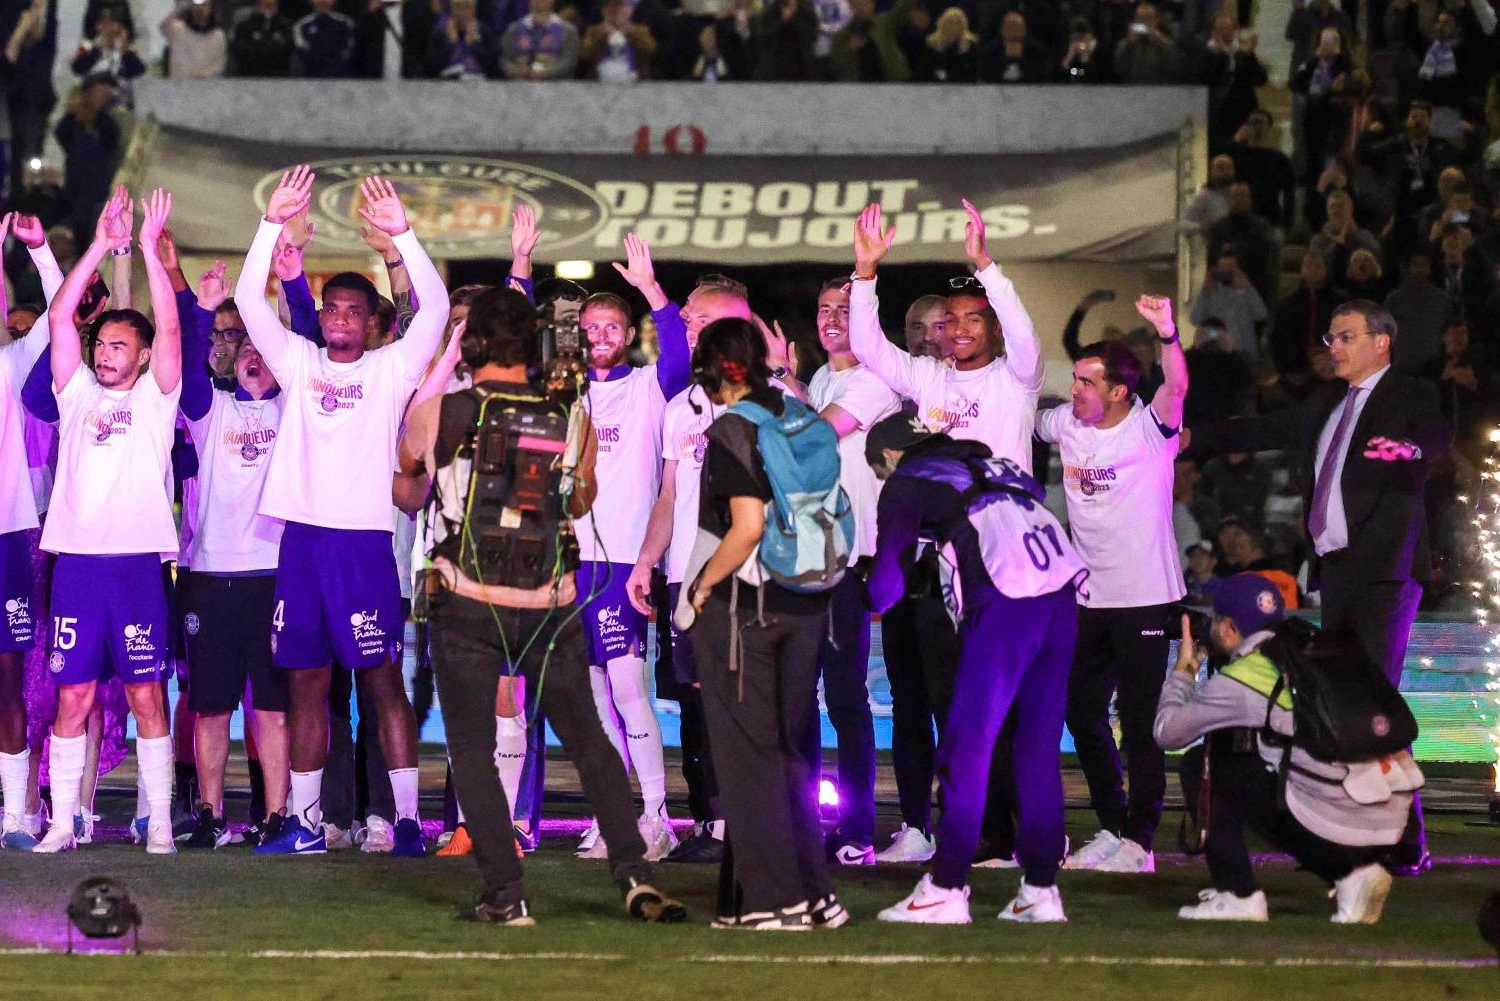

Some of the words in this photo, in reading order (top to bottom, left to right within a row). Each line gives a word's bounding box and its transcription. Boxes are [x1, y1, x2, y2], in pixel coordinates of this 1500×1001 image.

[633, 124, 708, 154] 10
[595, 181, 940, 215] DEBOUT.
[16, 597, 29, 609] Sud
[17, 609, 29, 617] de
[361, 609, 378, 622] Sud
[606, 604, 621, 617] Sud
[363, 621, 376, 630] de
[606, 617, 619, 626] de
[53, 616, 78, 650] 15
[135, 623, 152, 636] Sud
[352, 625, 386, 640] France
[599, 622, 628, 637] France
[125, 638, 156, 652] France
[135, 636, 149, 644] de
[134, 666, 153, 674] CRAFT
